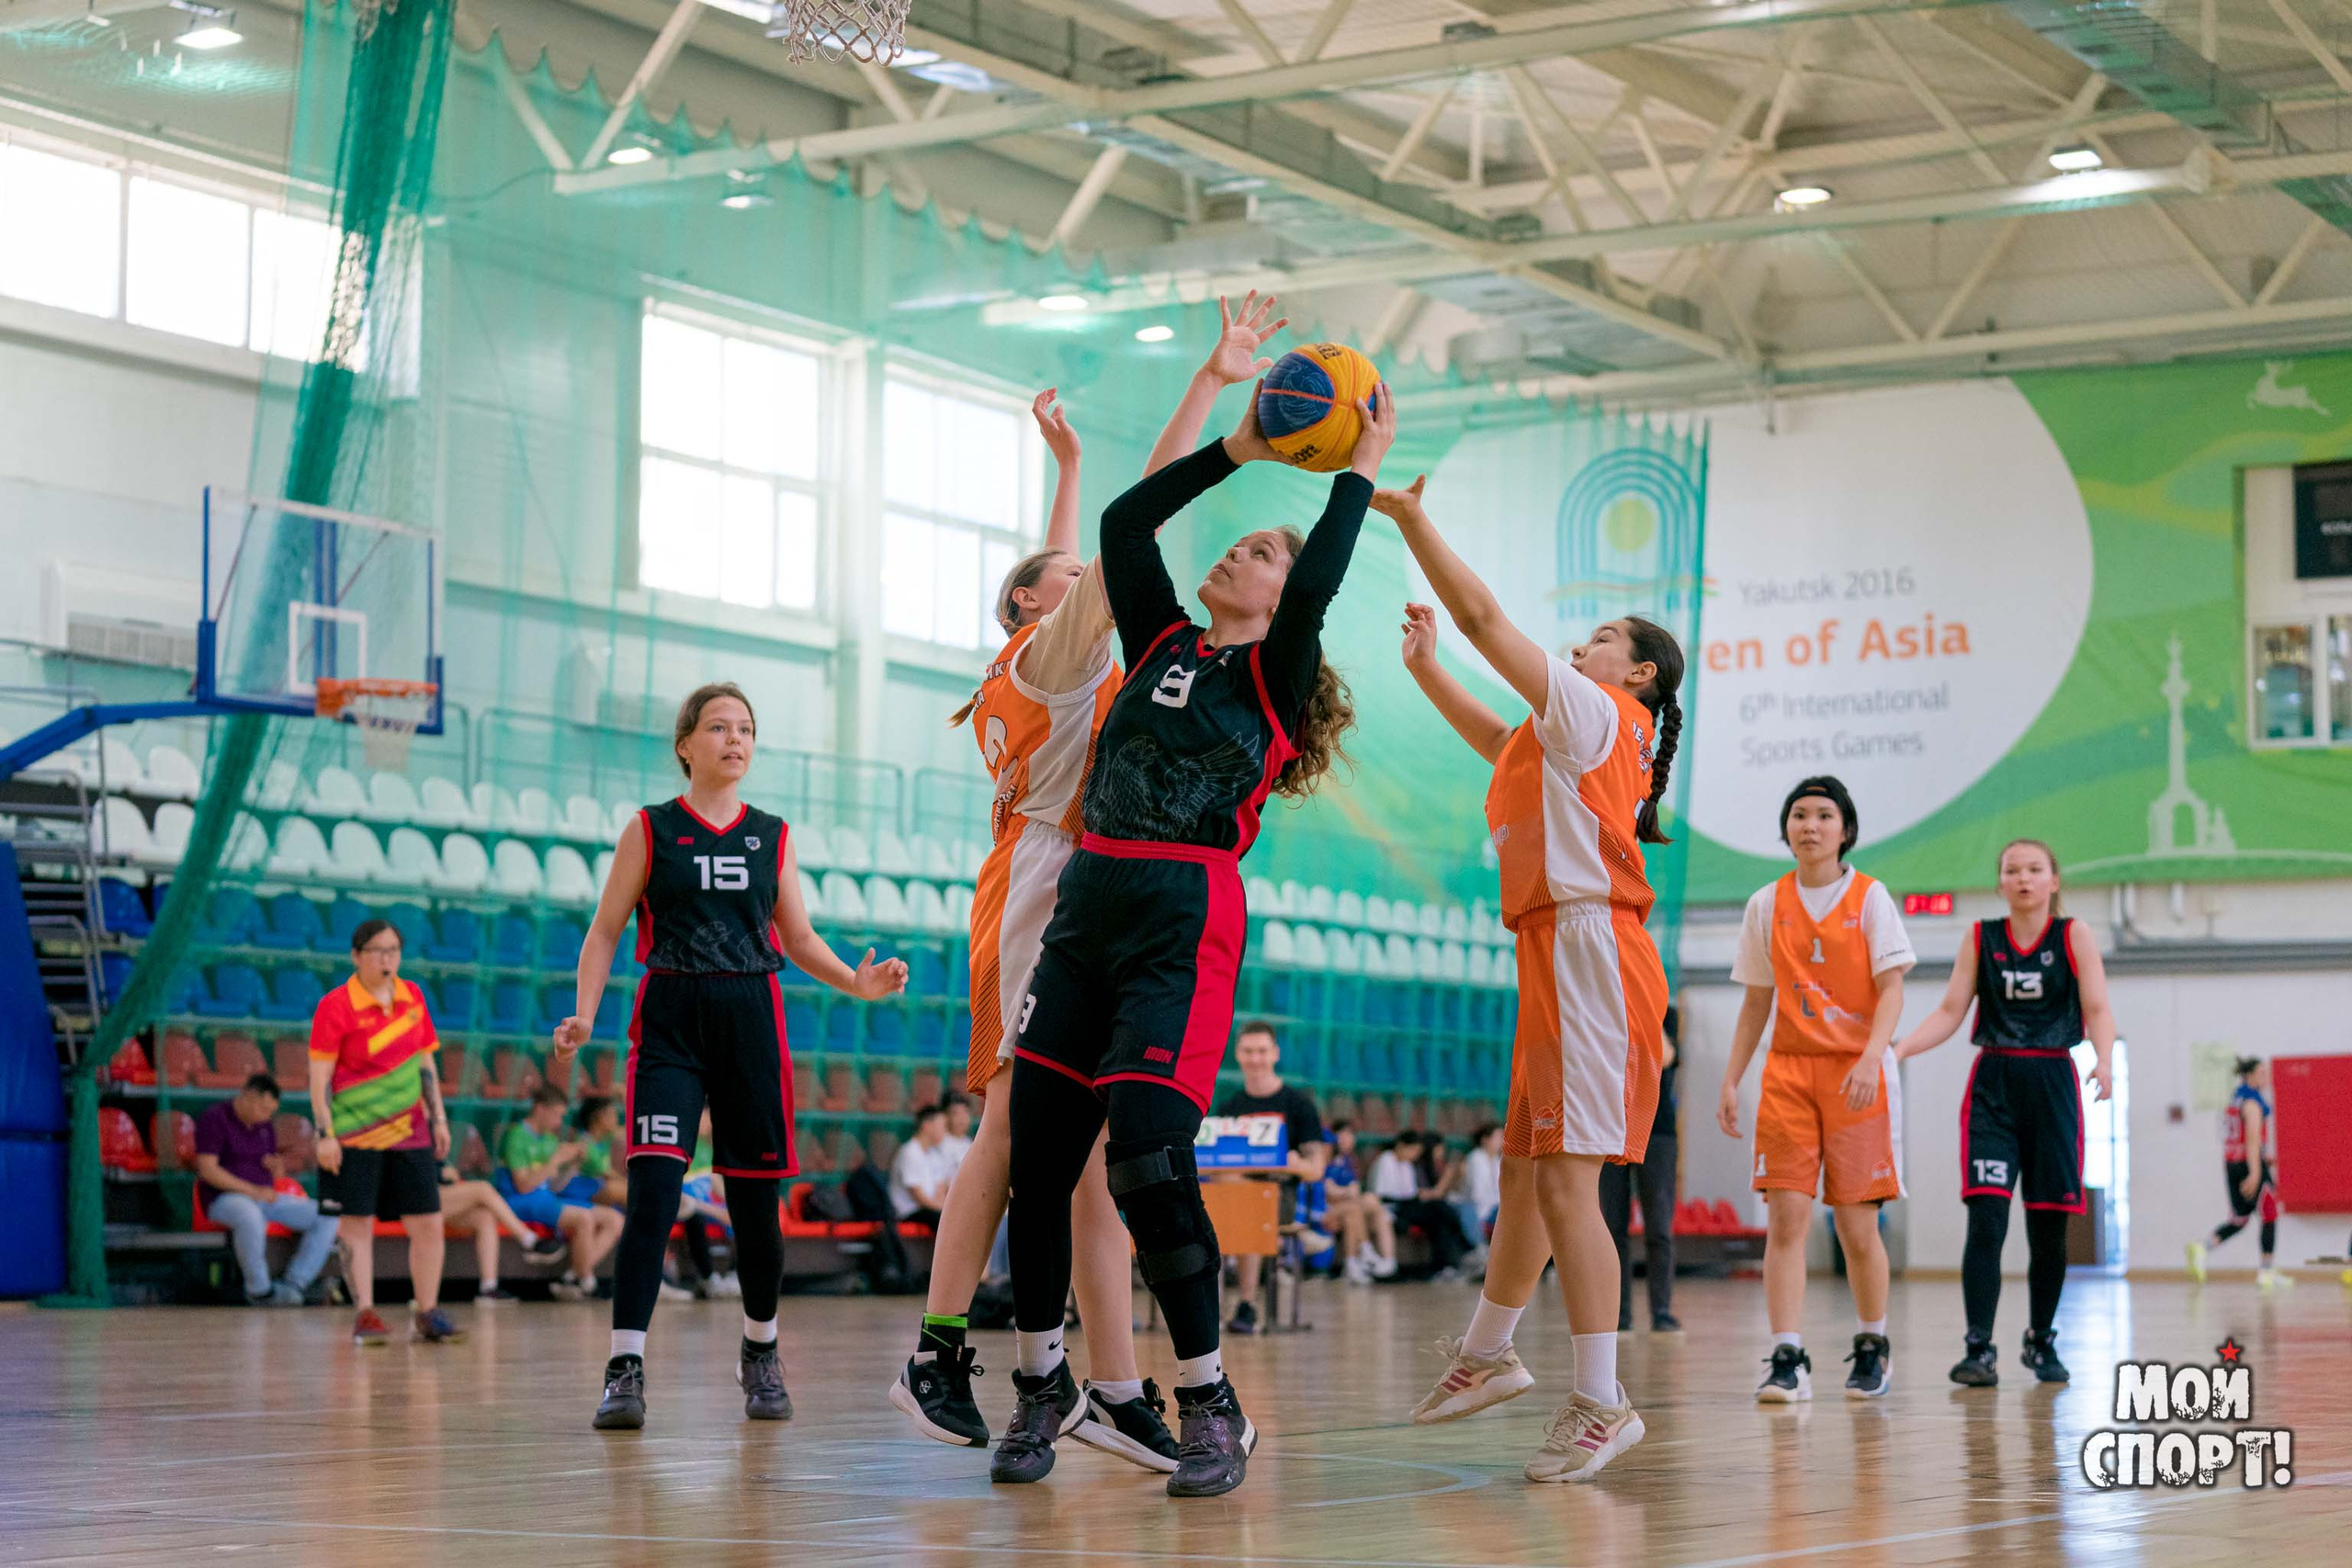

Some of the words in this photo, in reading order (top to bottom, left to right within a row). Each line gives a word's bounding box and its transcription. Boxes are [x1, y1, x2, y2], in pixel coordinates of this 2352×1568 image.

[1738, 572, 1837, 606] Yakutsk
[1842, 566, 1917, 600] 2016
[1785, 618, 1838, 666] of
[1858, 611, 1972, 662] Asia
[1151, 664, 1197, 708] 9
[1738, 694, 1778, 724] 6th
[1782, 682, 1950, 716] International
[1740, 737, 1825, 769] Sports
[1832, 731, 1926, 761] Games
[693, 855, 749, 891] 15
[1810, 938, 1826, 964] 1
[2001, 971, 2043, 1000] 13
[637, 1114, 679, 1145] 15
[1257, 1122, 1272, 1142] 7
[1973, 1159, 2008, 1184] 13
